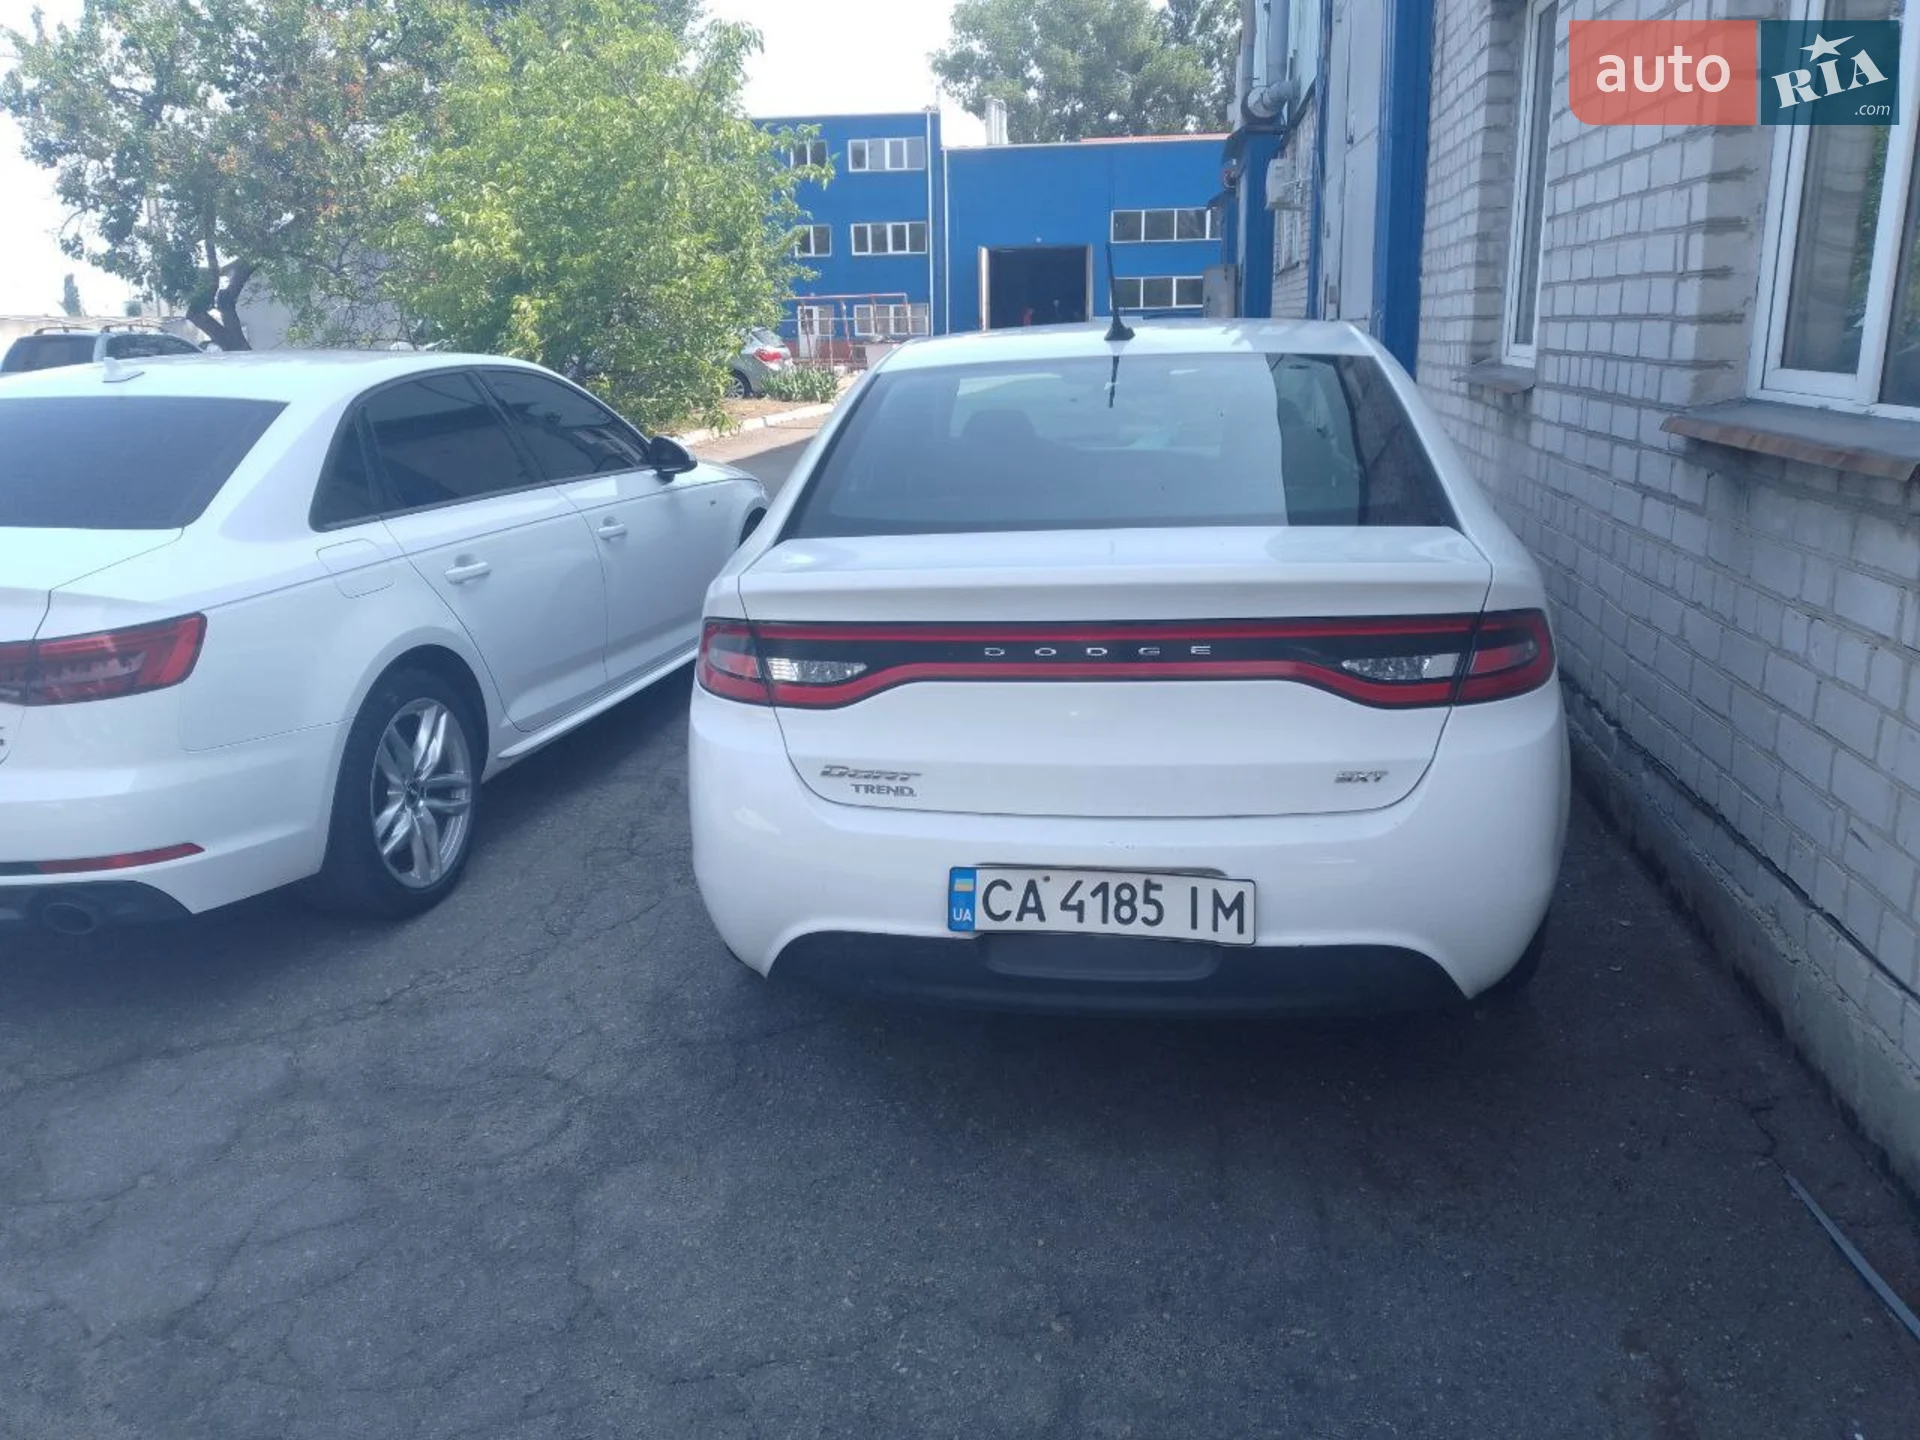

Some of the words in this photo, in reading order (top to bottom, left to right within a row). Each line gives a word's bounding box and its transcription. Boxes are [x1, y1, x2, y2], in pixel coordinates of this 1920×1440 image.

[984, 645, 1211, 656] DODGE
[981, 878, 1047, 922] CA
[1060, 879, 1165, 927] 4185
[1190, 885, 1245, 935] IM
[952, 907, 973, 922] UA
